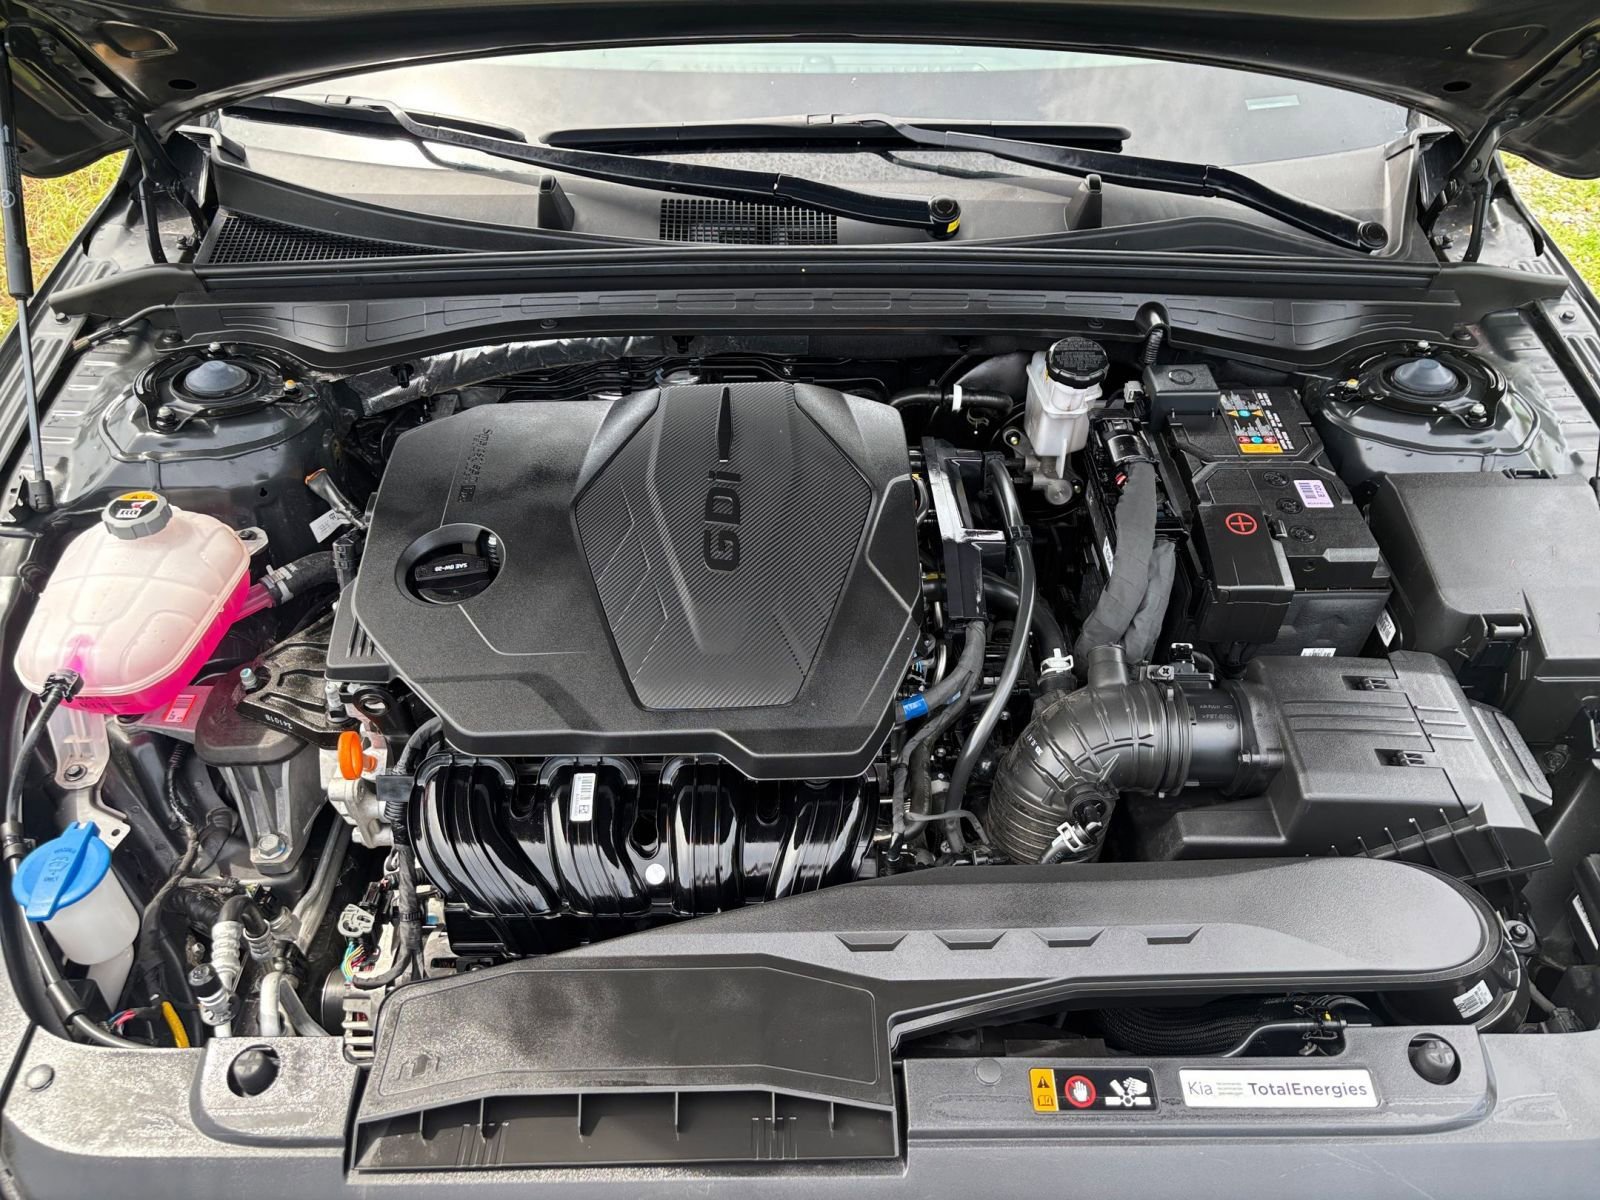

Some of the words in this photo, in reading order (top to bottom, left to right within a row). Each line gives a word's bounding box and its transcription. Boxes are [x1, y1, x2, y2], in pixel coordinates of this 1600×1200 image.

[704, 470, 741, 572] GDi
[434, 564, 455, 572] 0W-20
[1187, 1081, 1213, 1096] Kia
[1247, 1081, 1367, 1098] TotalEnergies
